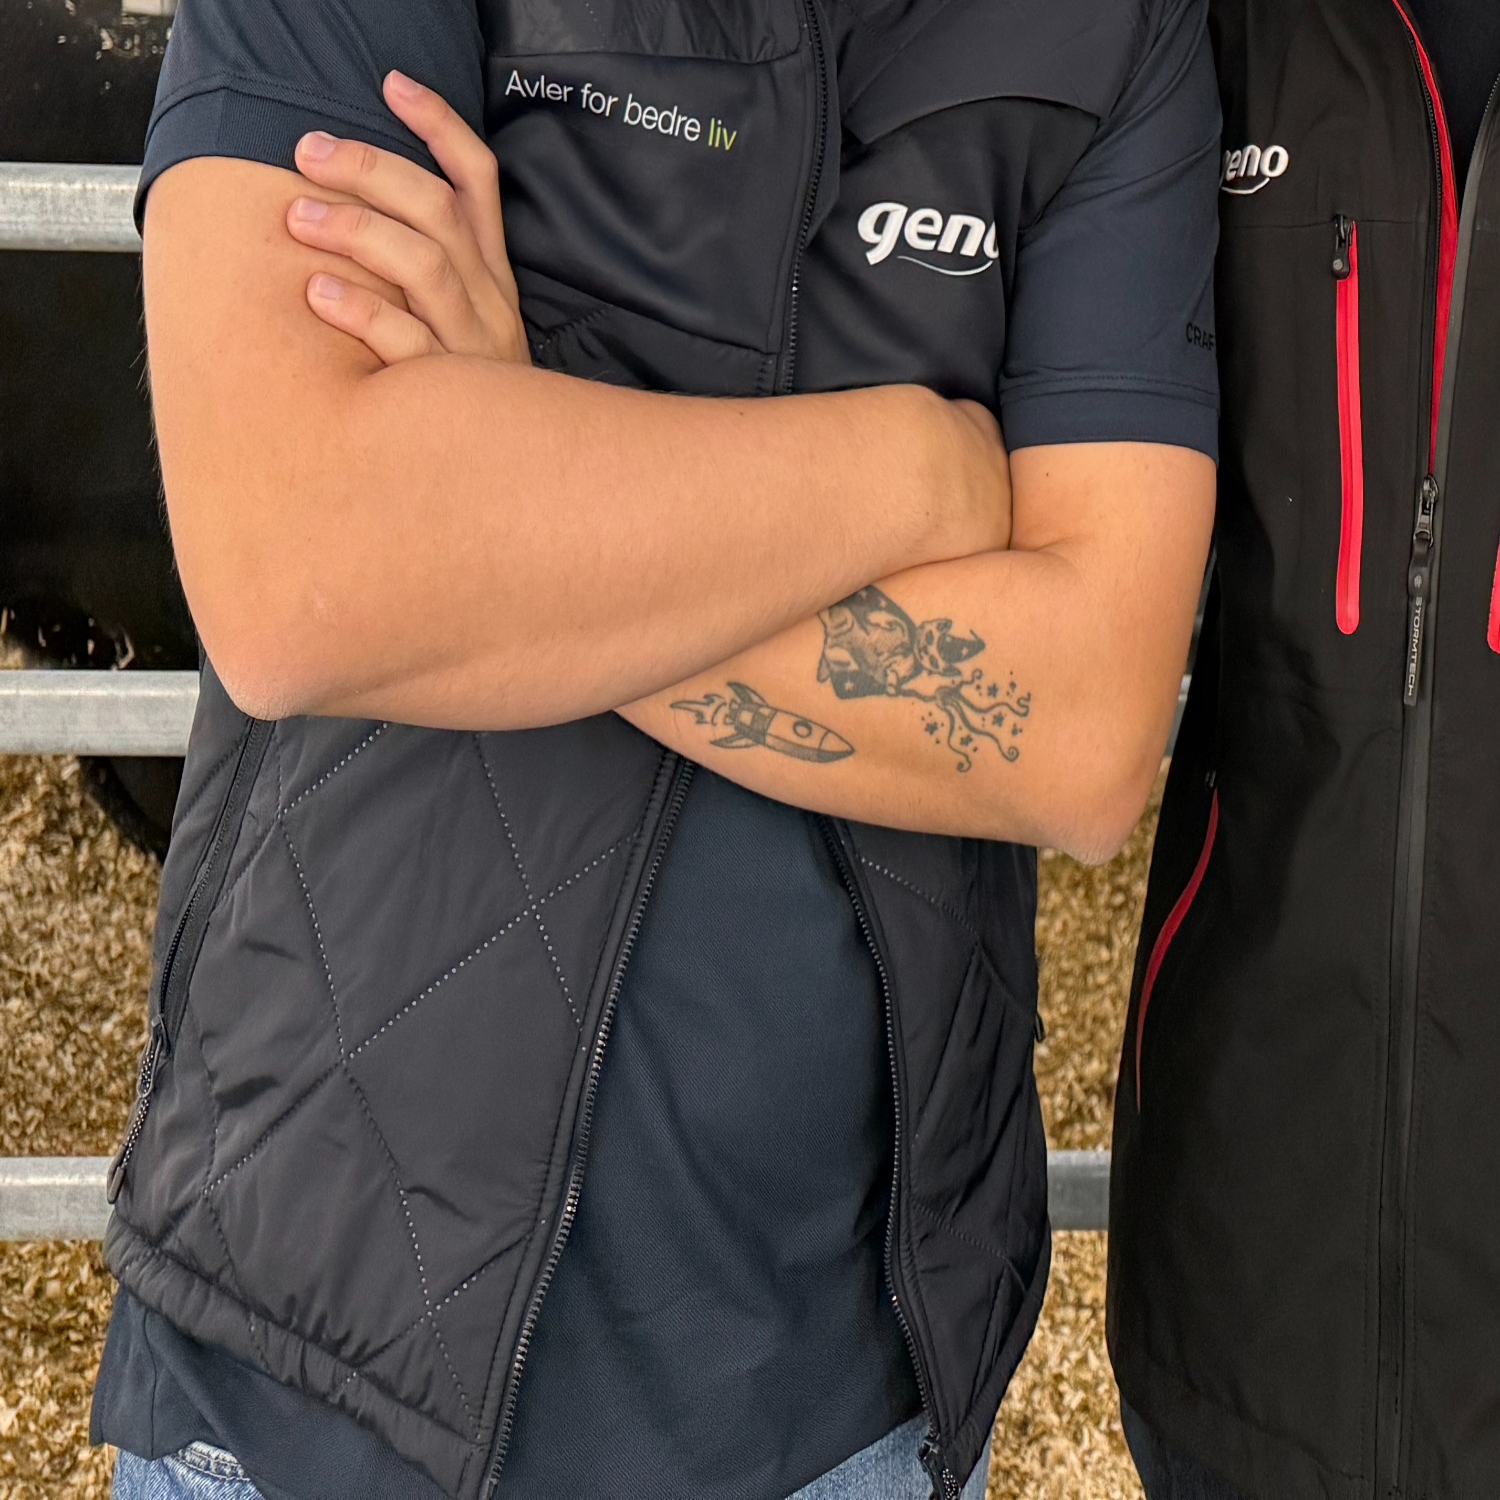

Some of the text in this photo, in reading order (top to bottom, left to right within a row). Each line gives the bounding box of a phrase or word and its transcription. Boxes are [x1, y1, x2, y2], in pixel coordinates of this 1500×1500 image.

[505, 70, 737, 151] Avler for bedre liv
[1222, 144, 1289, 182] eno
